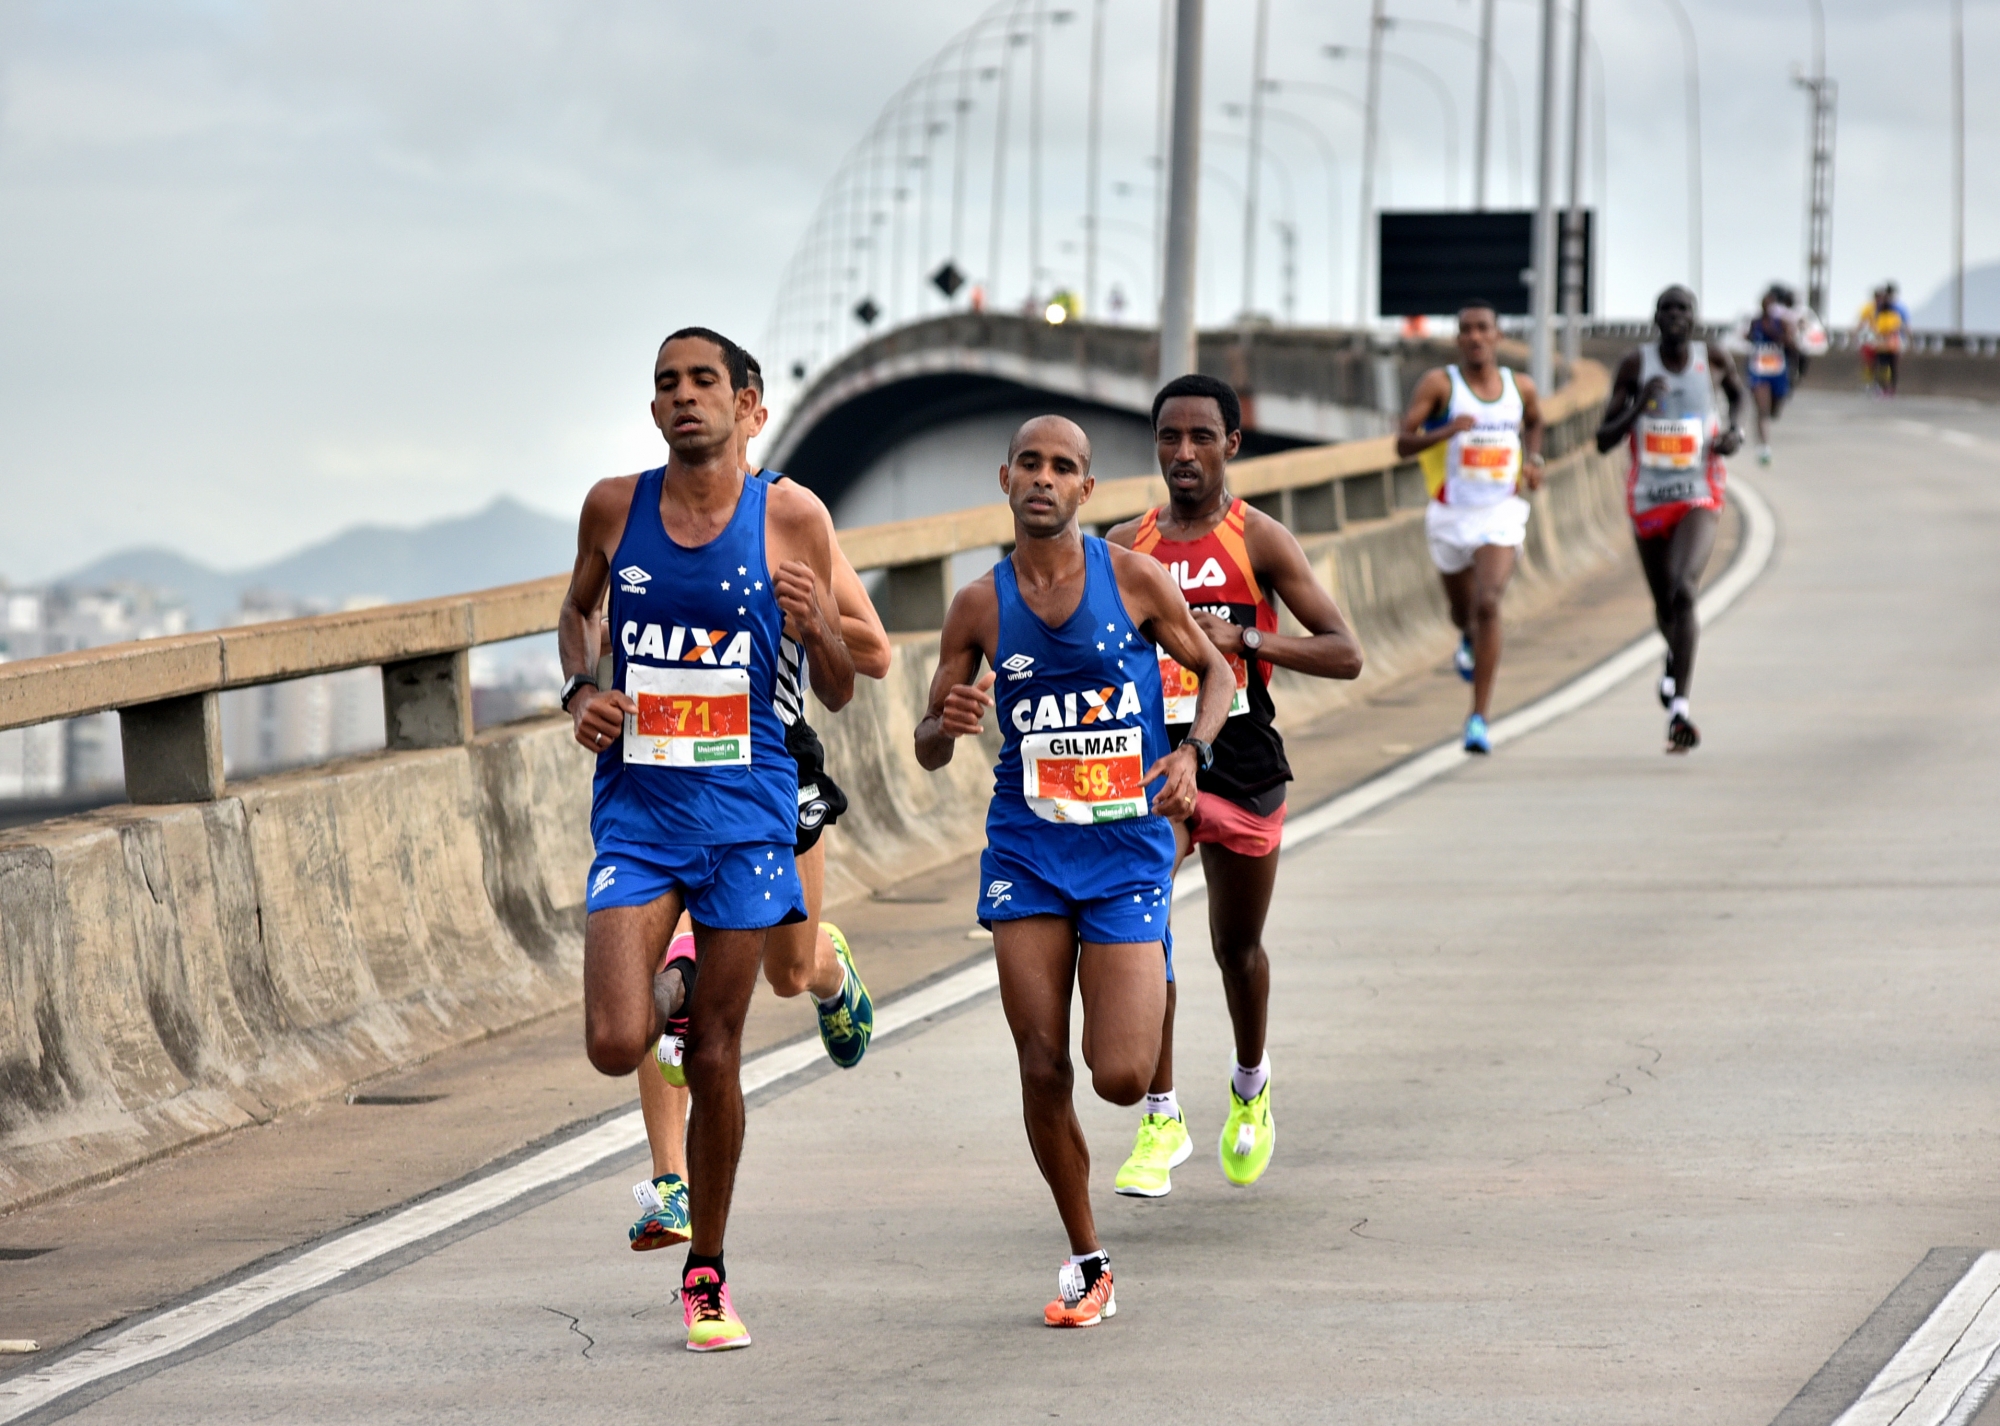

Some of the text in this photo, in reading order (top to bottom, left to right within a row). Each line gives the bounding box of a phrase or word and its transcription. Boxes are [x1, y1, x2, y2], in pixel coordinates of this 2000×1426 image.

[1163, 557, 1227, 590] ILA
[621, 584, 646, 595] umbro
[621, 620, 750, 666] CAIXA
[1008, 670, 1033, 681] umbro
[673, 701, 710, 732] 71
[1012, 681, 1142, 733] CAIXA
[1050, 736, 1128, 756] GILMAR
[1073, 763, 1109, 797] 59
[1096, 804, 1123, 817] Unimed
